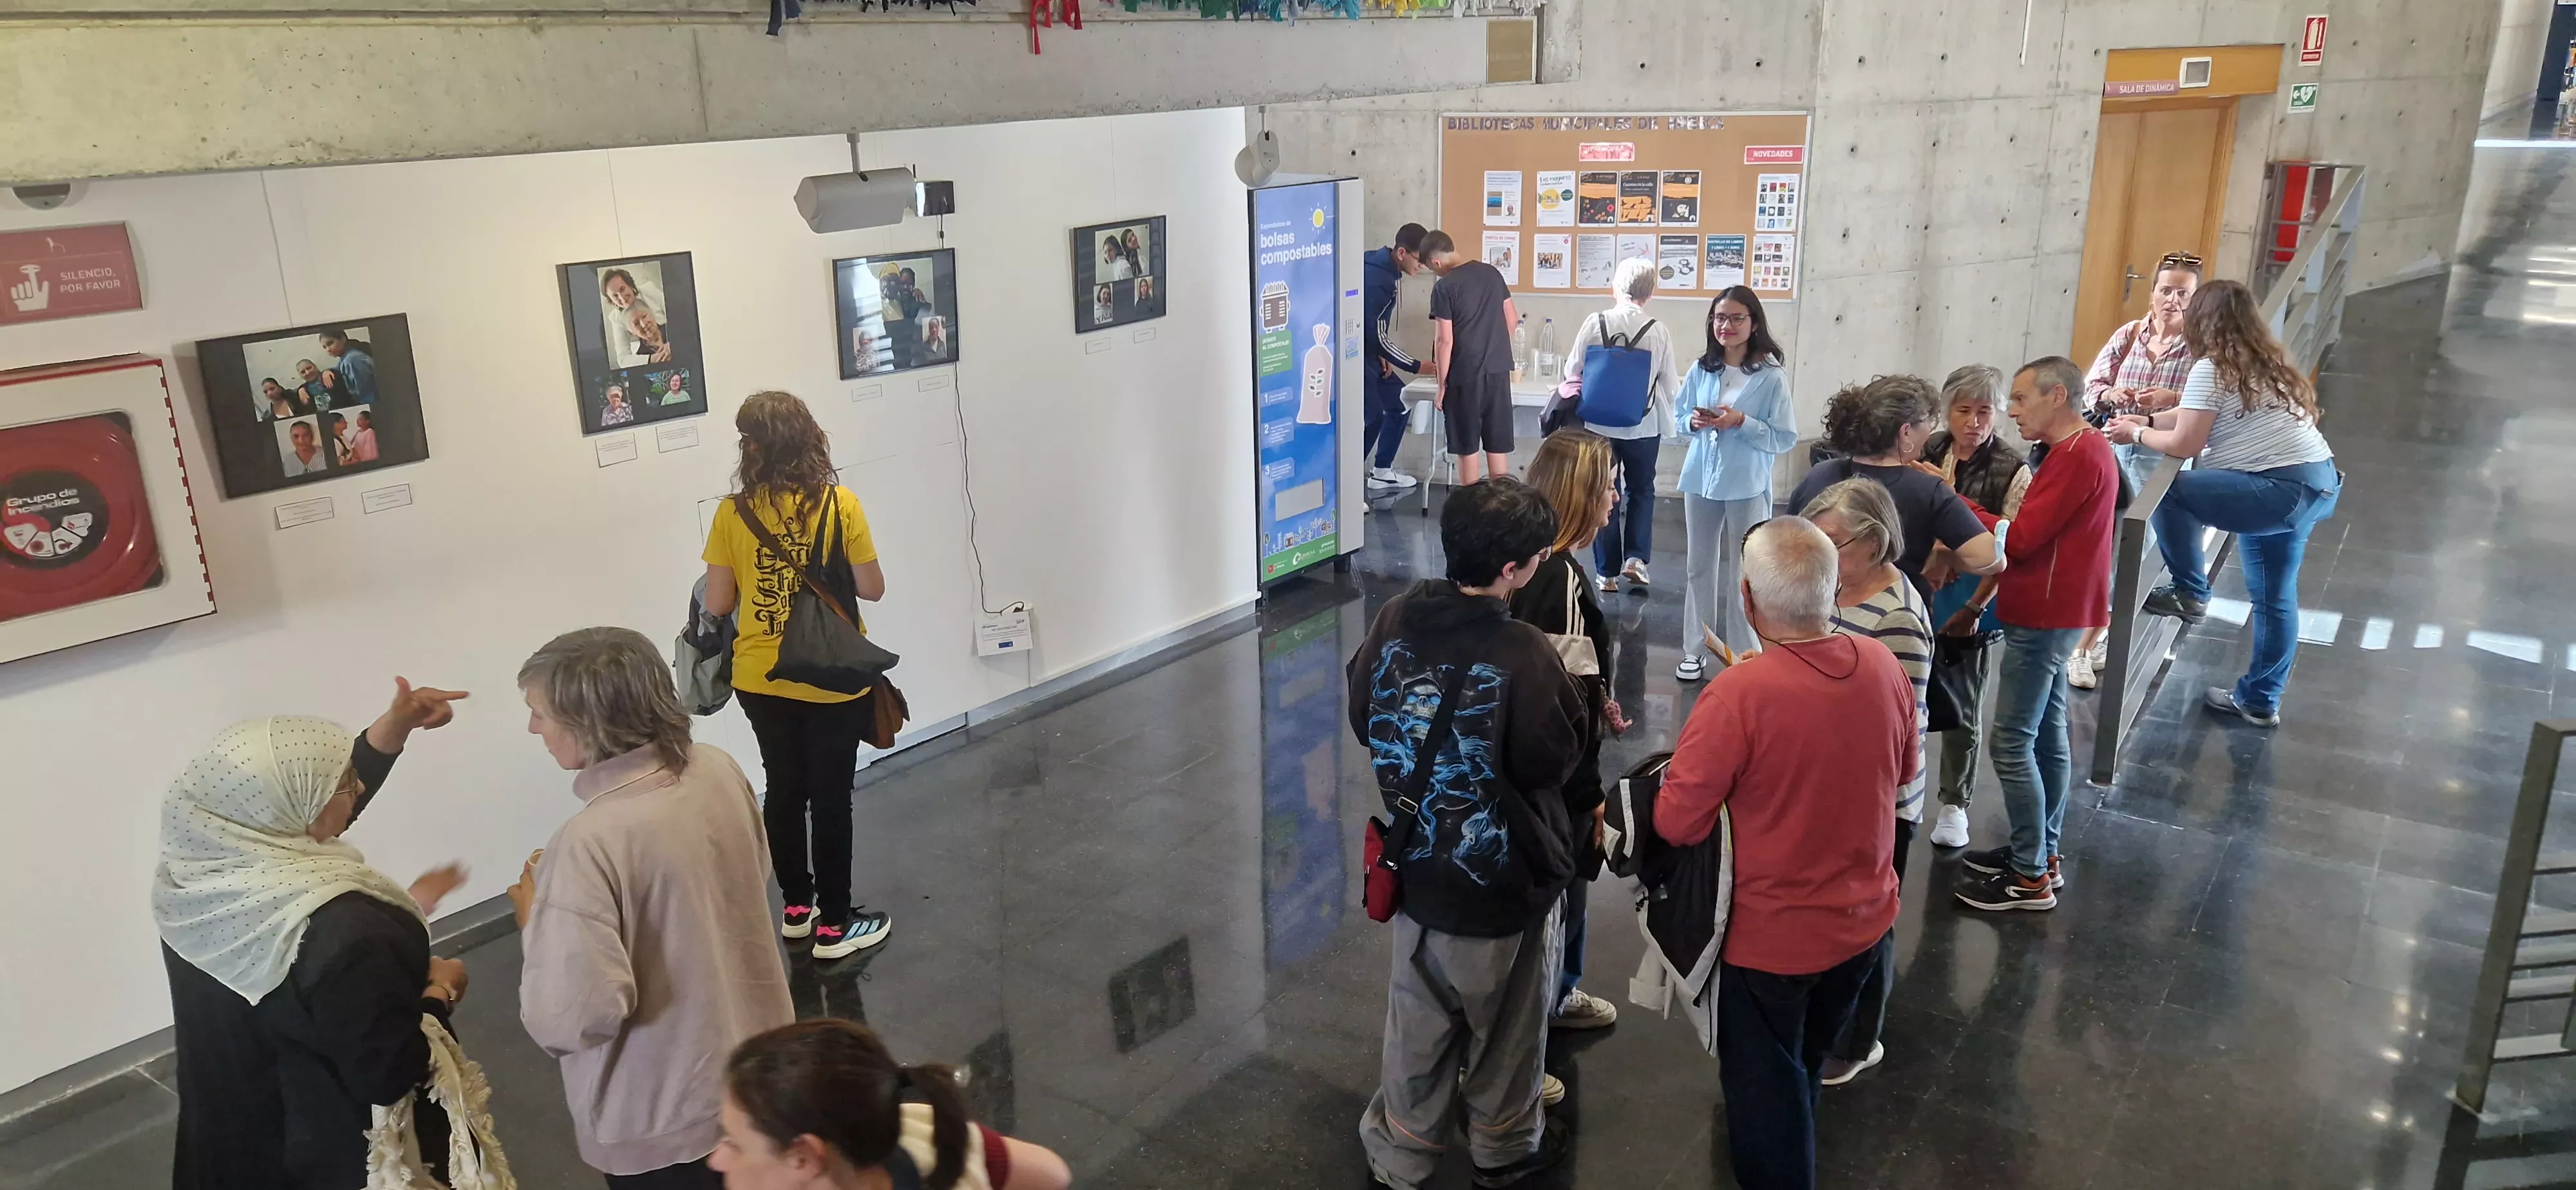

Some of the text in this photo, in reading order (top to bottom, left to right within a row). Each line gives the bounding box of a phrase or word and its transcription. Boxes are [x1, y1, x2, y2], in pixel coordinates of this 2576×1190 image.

[2119, 82, 2174, 93] SALA DE DINÁMICA
[1448, 117, 1535, 131] BIBLIOTECAS
[1638, 117, 1658, 130] DE
[1753, 149, 1794, 158] NOVEDADES
[1260, 232, 1295, 249] bolsas
[1260, 241, 1332, 266] compostables
[60, 267, 116, 281] SILENCIO,
[60, 279, 120, 293] POR FAVOR
[1264, 393, 1268, 403] 1
[1264, 424, 1269, 434] 2
[1265, 465, 1270, 475] 3
[6, 488, 78, 507] Grupo de
[7, 497, 80, 516] Incendios
